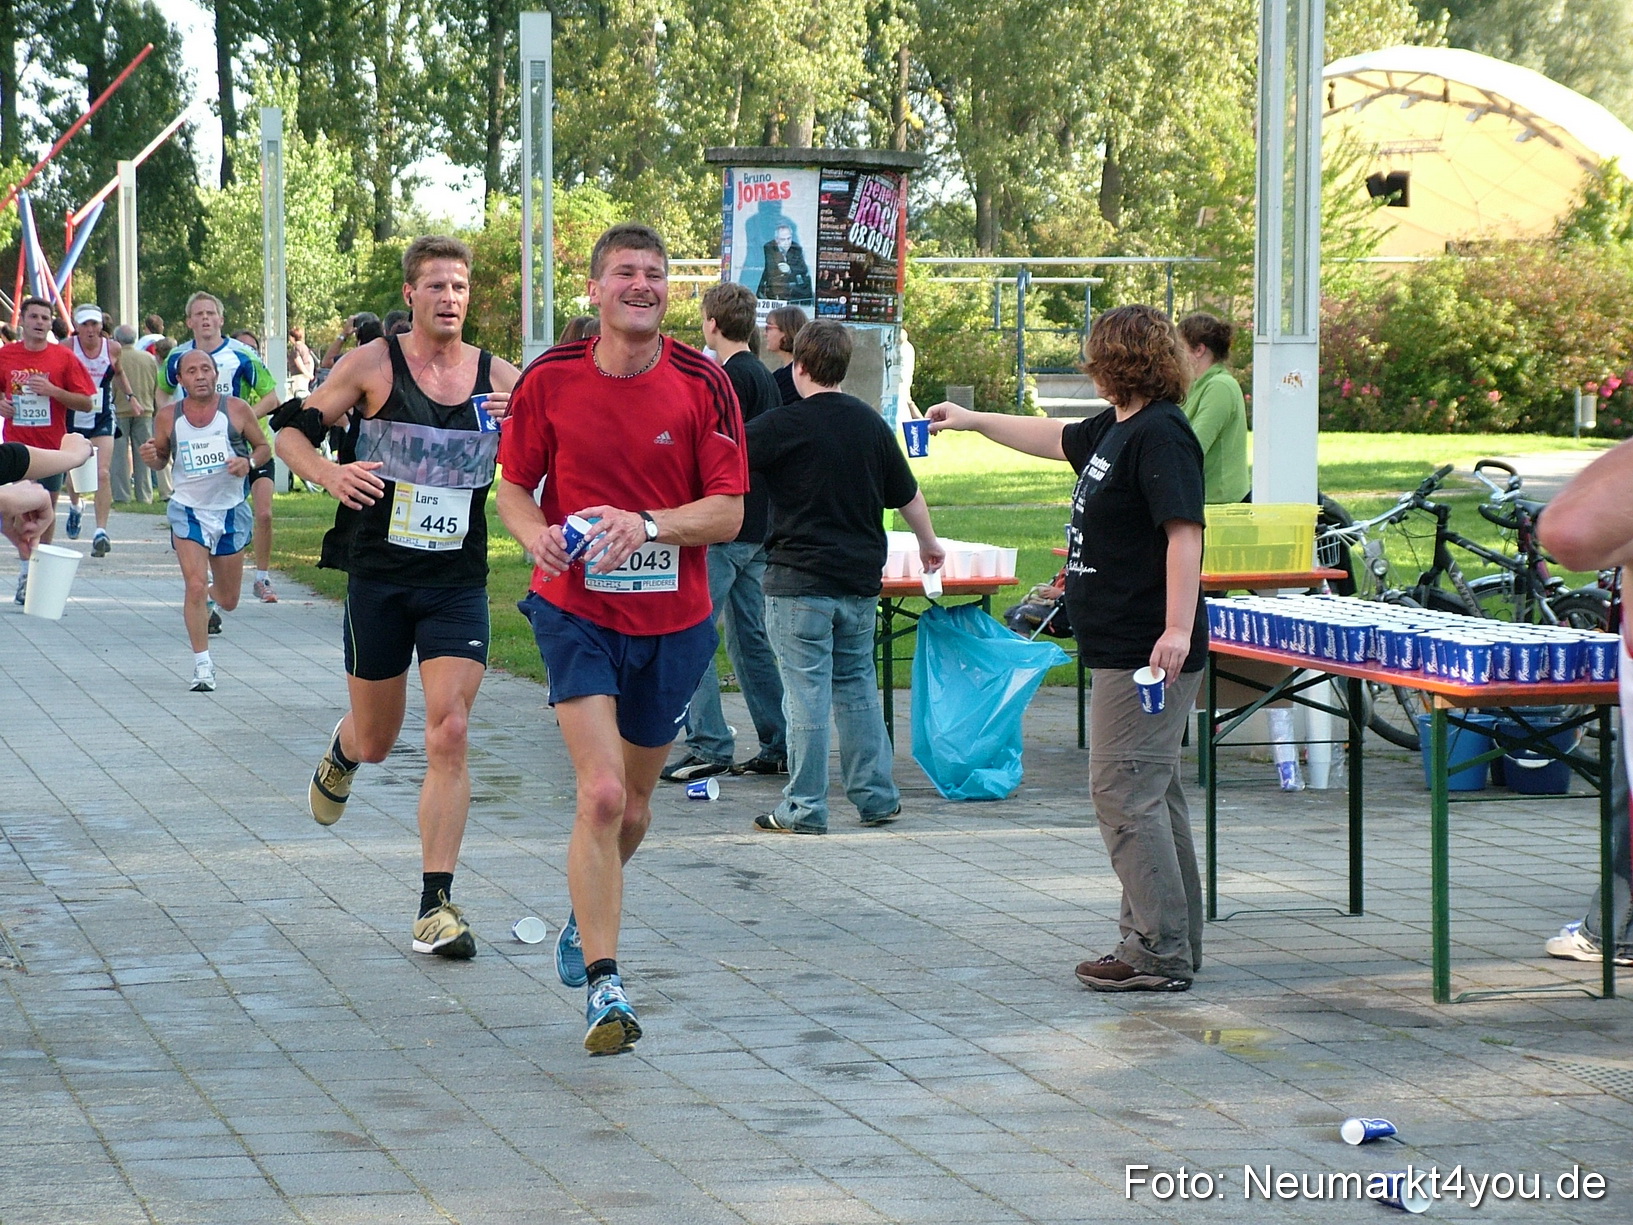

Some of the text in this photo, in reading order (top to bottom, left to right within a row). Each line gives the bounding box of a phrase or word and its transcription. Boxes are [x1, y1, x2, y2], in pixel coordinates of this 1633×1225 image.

[743, 172, 772, 184] Bruno
[737, 180, 792, 212] Jonas
[848, 222, 895, 260] 08.09.07
[22, 408, 47, 418] 3230
[191, 442, 210, 450] Viktor
[195, 452, 226, 466] 3098
[415, 490, 439, 505] Lars
[395, 506, 401, 515] A
[420, 514, 458, 534] 445
[614, 550, 671, 571] 043
